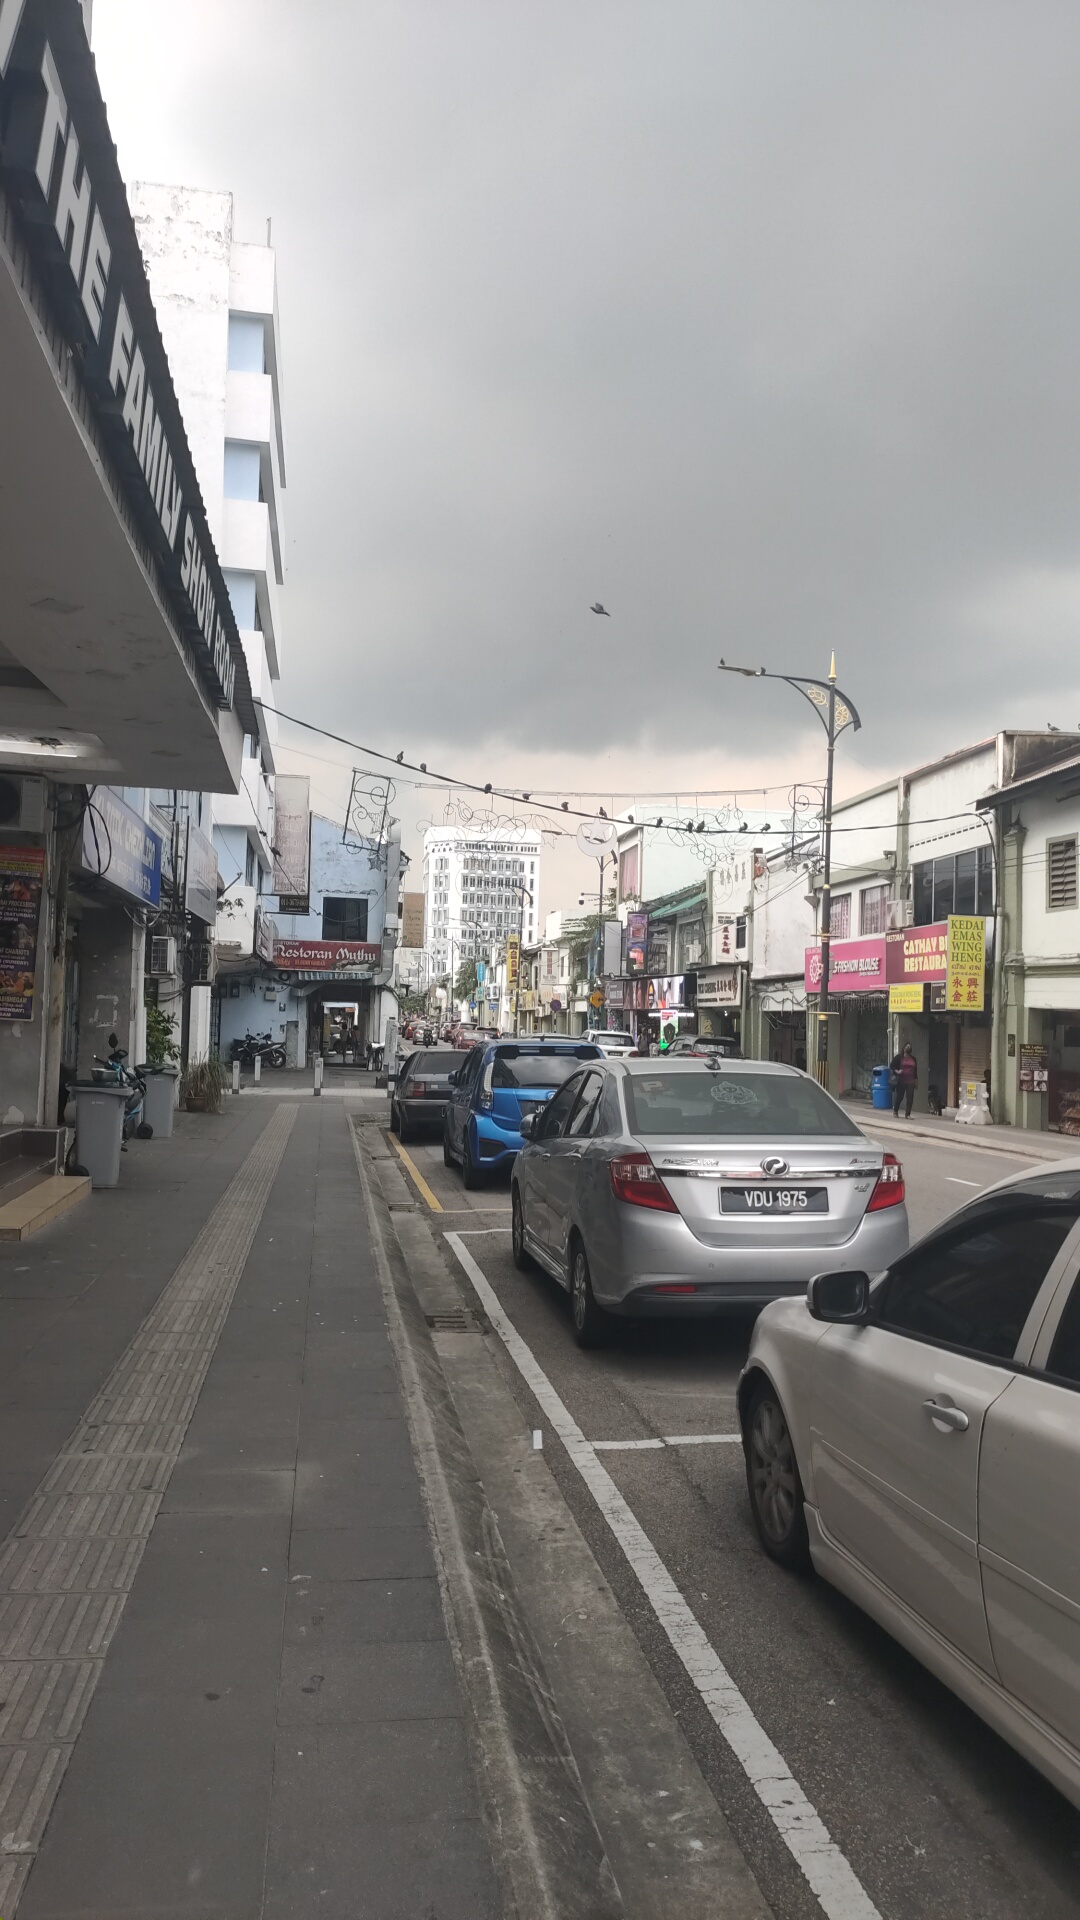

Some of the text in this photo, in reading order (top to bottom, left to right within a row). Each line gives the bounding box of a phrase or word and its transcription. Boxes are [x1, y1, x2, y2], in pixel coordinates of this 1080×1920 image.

[35, 39, 236, 712] THE FAMILY SHOW ROOM
[951, 919, 985, 931] KEDAI
[953, 930, 982, 942] EMAS
[275, 944, 376, 961] Restoran Muthu
[904, 938, 936, 955] CATHAY
[952, 941, 982, 952] WING
[858, 957, 879, 971] BLOUSE
[951, 952, 982, 963] HENG
[952, 976, 979, 989] 永興
[744, 1191, 808, 1207] VDU 1975
